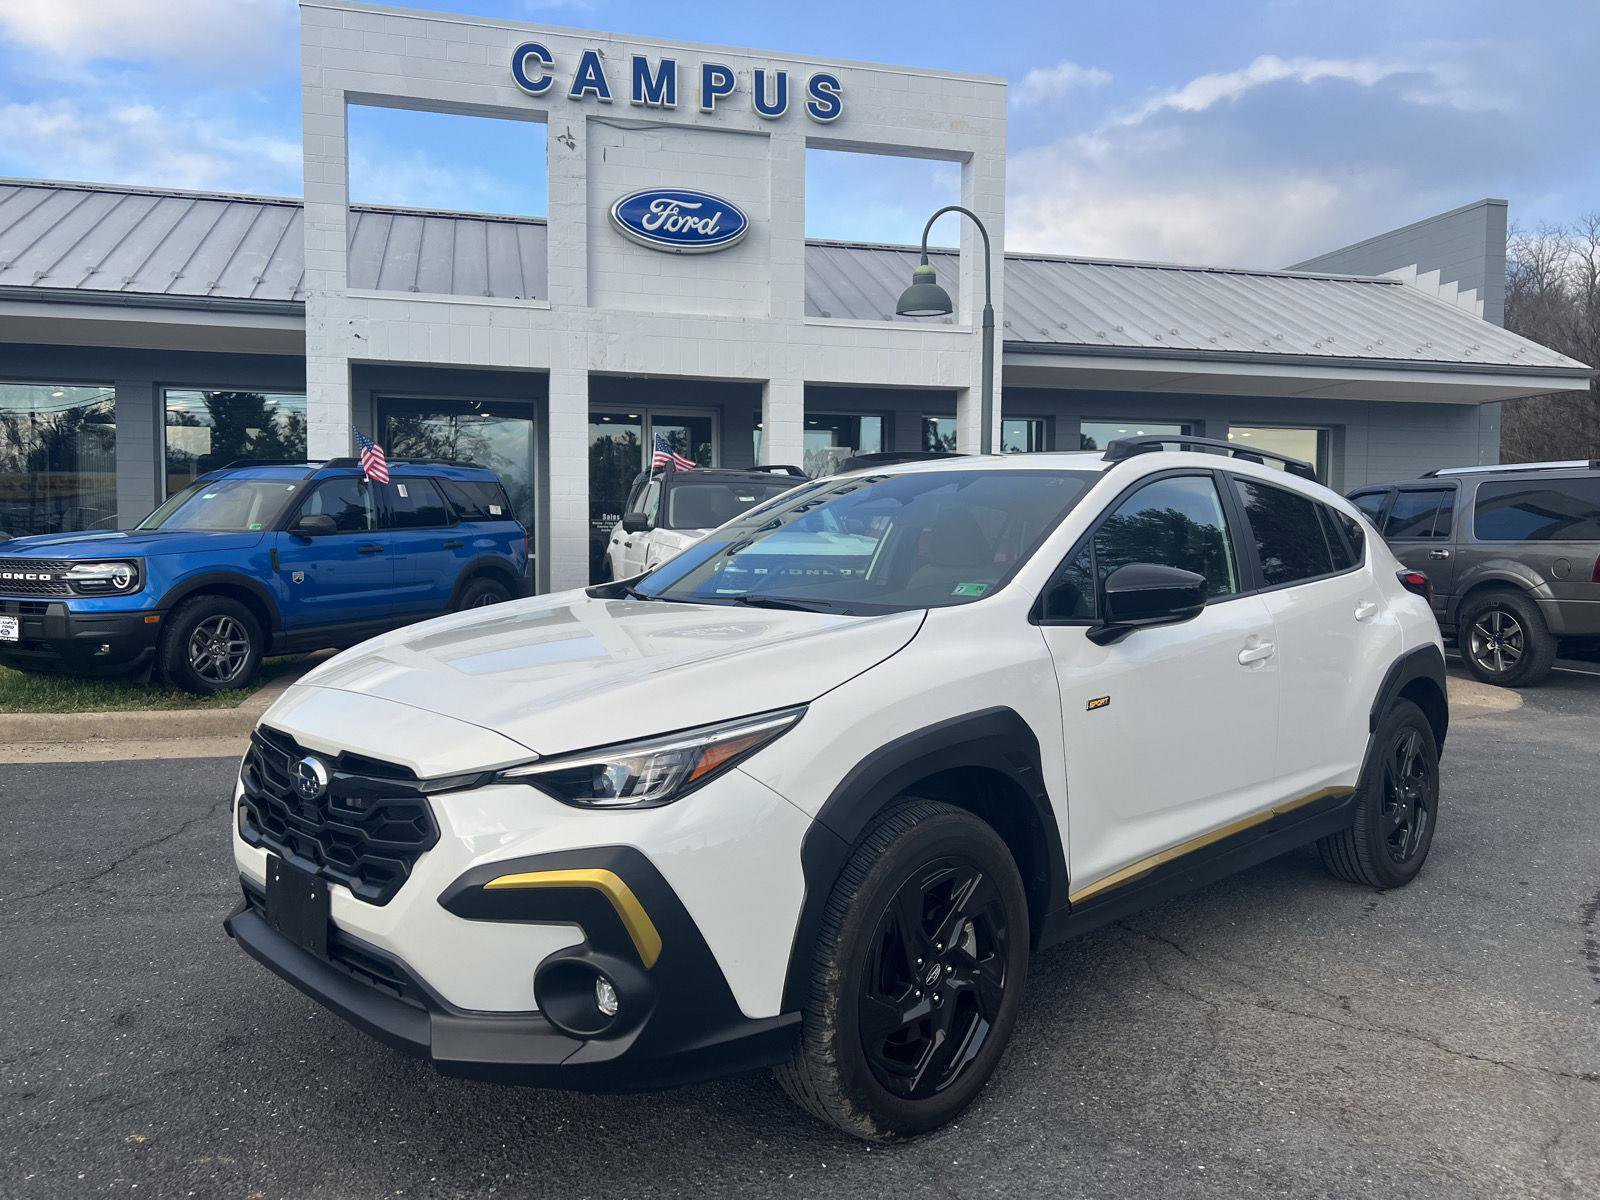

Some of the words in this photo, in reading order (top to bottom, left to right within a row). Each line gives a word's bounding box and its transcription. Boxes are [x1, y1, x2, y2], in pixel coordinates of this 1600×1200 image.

[510, 41, 843, 122] CAMPUS
[641, 198, 721, 236] Ford
[602, 513, 620, 521] Sales
[0, 572, 51, 580] ONCO
[1089, 697, 1109, 709] SPORT
